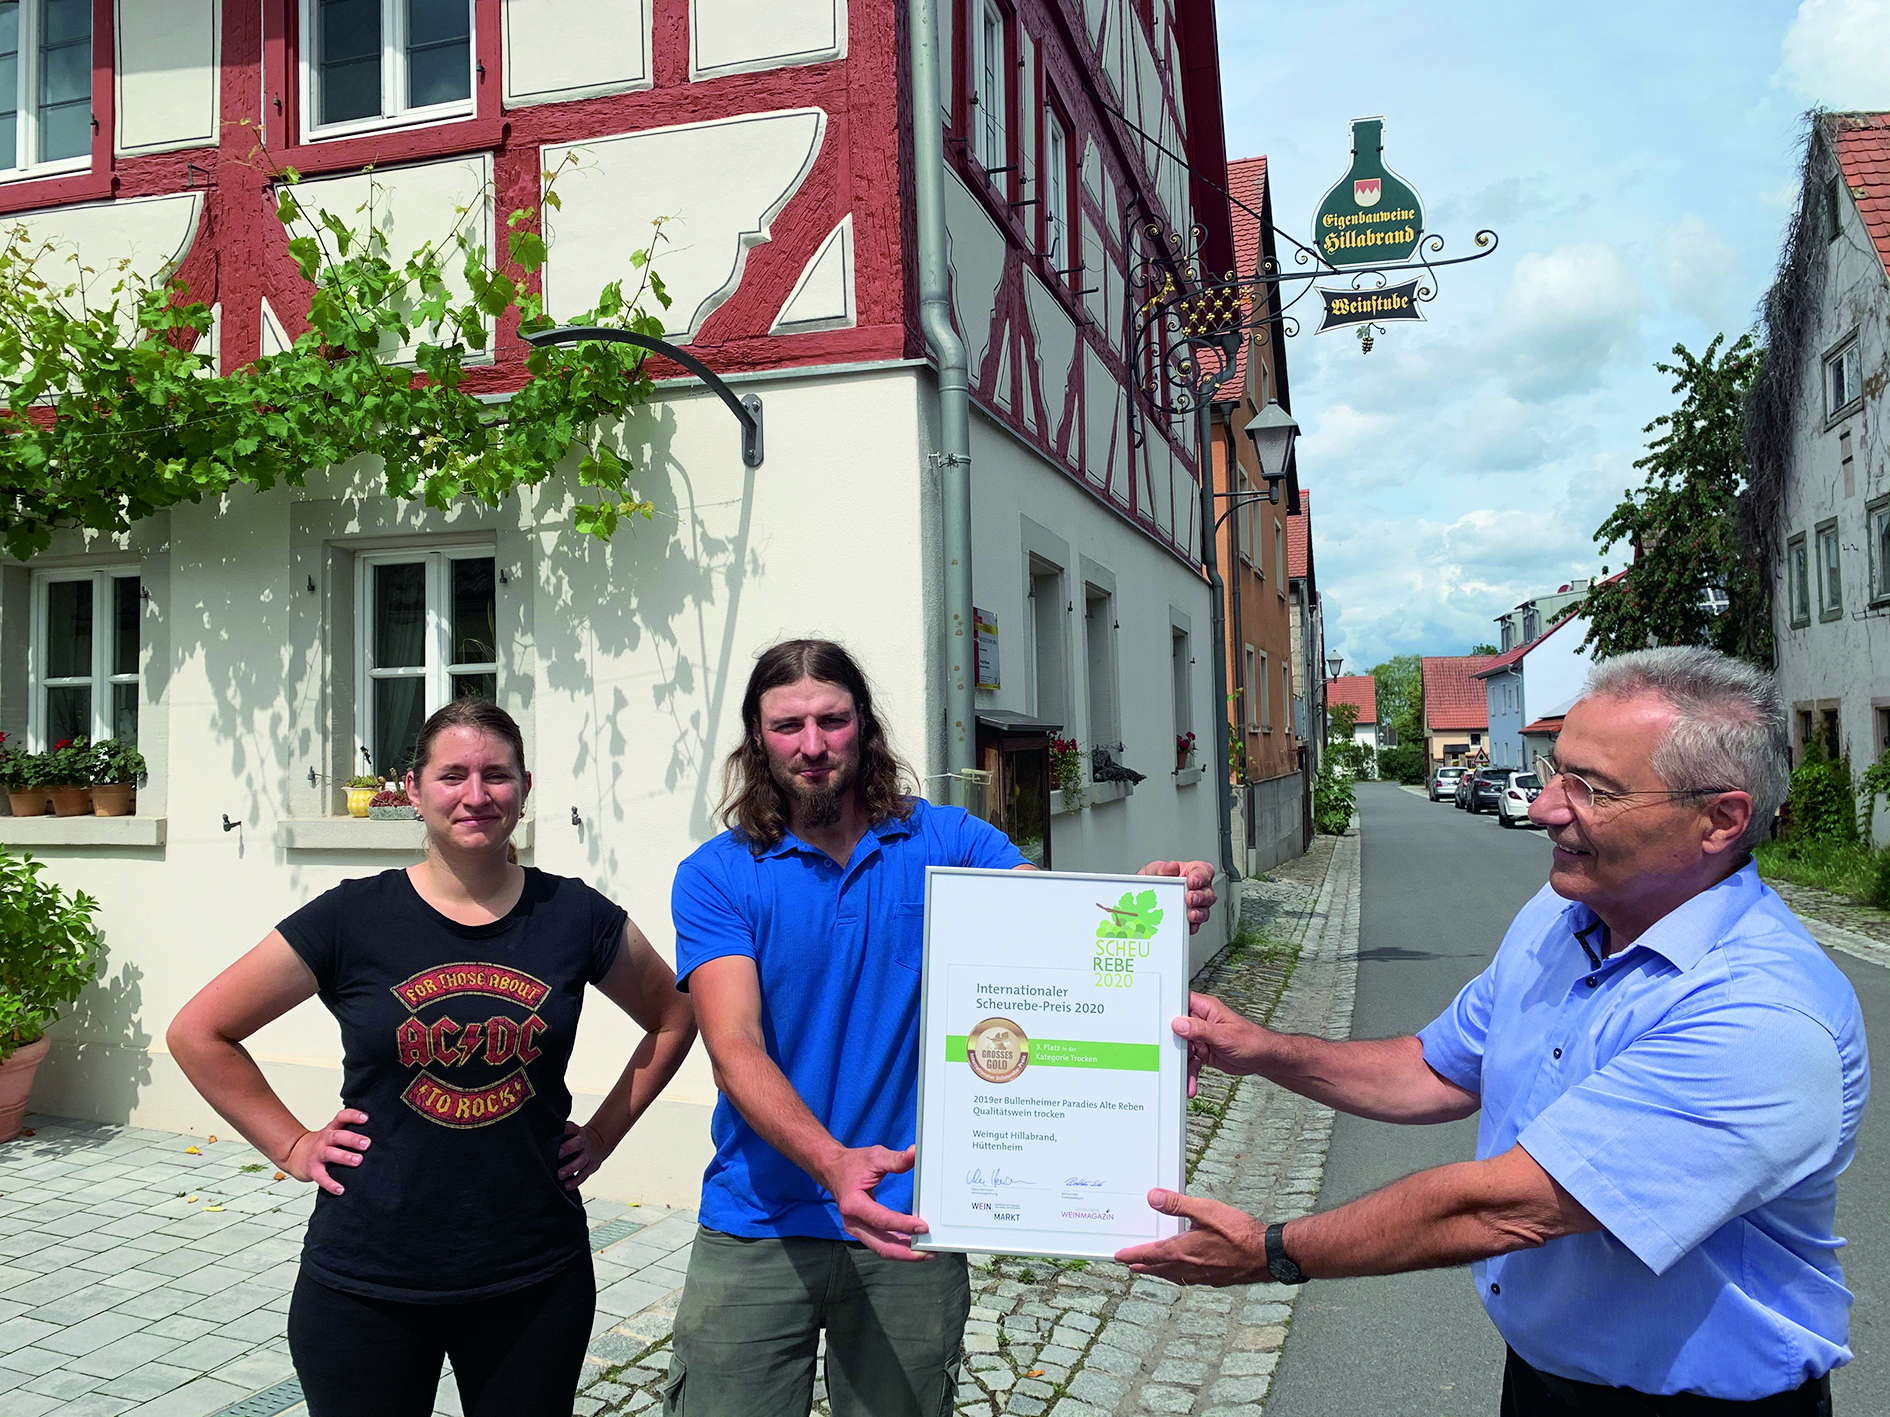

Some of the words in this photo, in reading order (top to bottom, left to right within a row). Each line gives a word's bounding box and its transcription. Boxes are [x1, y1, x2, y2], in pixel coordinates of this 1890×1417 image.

[1323, 208, 1415, 230] Eigenbauweine
[1324, 225, 1415, 255] Hillabrand
[1096, 939, 1150, 958] SCHEU
[1093, 957, 1134, 972] REBE
[406, 979, 438, 1001] FOR
[437, 972, 486, 988] THOSE
[489, 974, 541, 1000] ABOUT
[1094, 972, 1133, 988] 2020
[976, 983, 1069, 998] Internationaler
[976, 998, 1072, 1013] Scheurebe-Preis
[1075, 1002, 1105, 1014] 2020
[1043, 1043, 1060, 1051] Platz
[982, 1050, 1013, 1059] GROSSES
[1036, 1053, 1069, 1063] Kategorie
[1070, 1054, 1098, 1062] Trocken
[986, 1059, 1008, 1070] GOLD
[425, 1087, 450, 1112] TO
[456, 1087, 516, 1118] ROCK
[974, 1095, 1002, 1104] 2019er
[1004, 1096, 1060, 1107] Bullenheimer
[1062, 1099, 1098, 1109] Paradies
[1099, 1100, 1116, 1110] Alte
[1118, 1102, 1144, 1111] Reben
[973, 1106, 1032, 1118] Qualitätswein
[1034, 1109, 1065, 1118] trocken
[972, 1130, 1008, 1142] Weingut
[1010, 1131, 1058, 1142] Hillabrand,
[972, 1141, 1023, 1152] Hüttenheim
[971, 1202, 992, 1210] WEIN
[994, 1213, 1020, 1221] MARKT
[1061, 1211, 1114, 1220] WEINMAGAZIN
